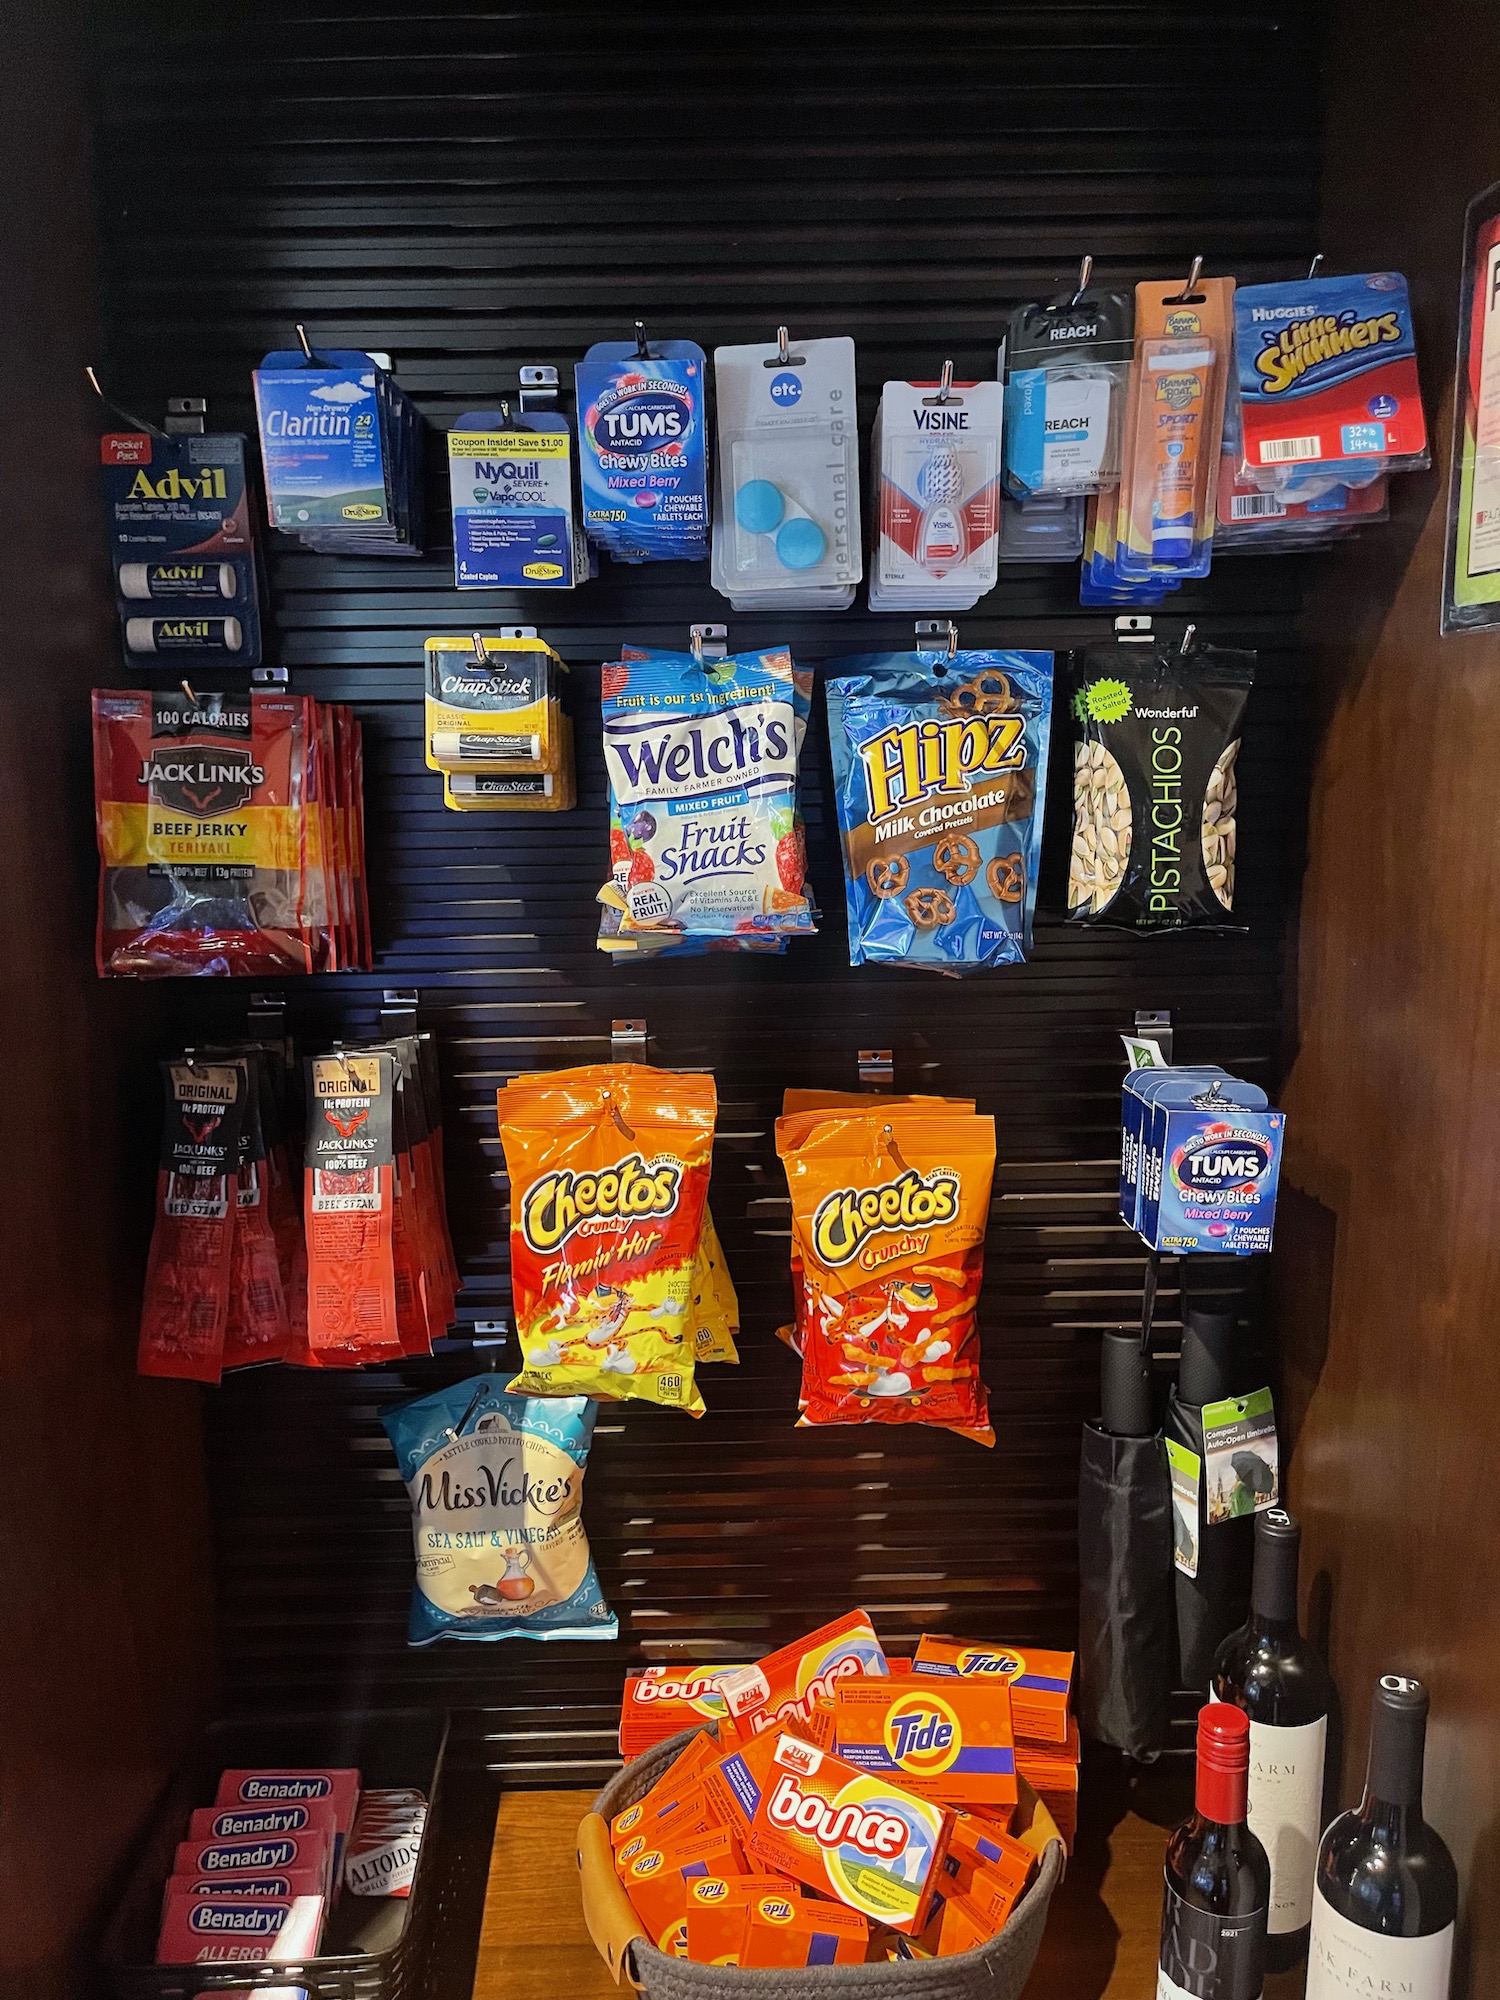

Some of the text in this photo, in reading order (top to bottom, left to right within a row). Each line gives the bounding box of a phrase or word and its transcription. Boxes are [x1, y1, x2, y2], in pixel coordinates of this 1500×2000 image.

[1252, 305, 1316, 322] HUGGIES
[1050, 324, 1097, 340] REACH
[617, 381, 688, 397] WORK IN SECONDS!
[772, 382, 802, 397] etc.
[1160, 378, 1198, 389] BANANA
[266, 410, 350, 437] Claritin
[356, 415, 371, 425] 24
[603, 412, 682, 437] TUMS
[913, 410, 969, 430] VISINE
[1045, 417, 1090, 430] REACH
[452, 438, 564, 447] Coupon Inside! Save $1.00
[610, 439, 642, 447] ANTACID
[1387, 432, 1397, 443] L
[110, 440, 144, 451] Pocket
[116, 451, 139, 461] Pack
[599, 453, 688, 472] Chewy Bites
[475, 461, 541, 485] NyQuil
[126, 467, 228, 499] Advil
[608, 475, 681, 490] Mixed Berry
[826, 389, 854, 583] personal care
[490, 491, 546, 503] VapoCOOL
[669, 495, 703, 503] POUCHES
[610, 510, 626, 521] 750
[664, 504, 702, 512] CHEWABLE
[652, 512, 703, 521] TABLETS EACH
[151, 565, 204, 579] Advil
[459, 561, 467, 573] 4
[543, 566, 561, 575] Store
[460, 573, 499, 582] Coated Caplets
[158, 621, 209, 637] Advil
[441, 676, 531, 698] ChapStick
[616, 692, 704, 707] Fruit is our 1st
[1091, 689, 1123, 704] Roasted
[1094, 697, 1127, 713] & Salted
[1134, 705, 1197, 719] Wonderful
[156, 710, 249, 728] 100 CALORIES
[466, 735, 523, 744] ChapStick
[611, 713, 788, 787] Welch's
[138, 761, 264, 785] JACK LINK'S
[863, 718, 1025, 819] Flipz
[482, 781, 536, 792] ChapStick
[645, 766, 760, 796] FAMILY FARMER OWNED
[675, 794, 743, 813] MIXED FRUIT
[875, 789, 1006, 845] Milk Chocolate
[1150, 726, 1183, 911] PISTACHIOS
[153, 823, 248, 837] BEEF JERKY
[681, 815, 752, 852] Fruit
[914, 816, 974, 839] Covered Pretzels
[169, 841, 231, 854] TERIYAKI
[659, 840, 767, 882] Snacks
[173, 866, 194, 877] 100%
[215, 867, 253, 879] 13g PROTEIN
[633, 892, 661, 908] REAL
[690, 888, 757, 897] Excellent Source
[690, 896, 696, 904] of
[632, 902, 669, 919] FRUIT!
[179, 1084, 233, 1100] ORIGINAL
[319, 1080, 376, 1093] ORIGINAL
[192, 1104, 226, 1115] PROTEIN
[335, 1097, 371, 1108] PROTEIN
[1204, 1130, 1270, 1142] WORK IN SECONDS!
[172, 1143, 195, 1155] JACK
[316, 1139, 375, 1151] JACK LINK'S
[196, 1165, 217, 1176] BEEF
[325, 1159, 368, 1170] 100% BEEF
[1188, 1156, 1259, 1177] TUMS
[318, 1199, 374, 1210] BEEF STEAK
[526, 1156, 674, 1248] Cheetos
[1179, 1190, 1261, 1205] Chewy Bites
[818, 1174, 955, 1259] Cheetos
[1184, 1208, 1253, 1221] Mixed Berry
[577, 1216, 631, 1238] Crunchy
[1239, 1227, 1270, 1235] POUCHES
[1182, 1237, 1198, 1247] 750
[1221, 1241, 1269, 1250] TABLETS EACH
[1232, 1234, 1269, 1242] CHEWABLE
[861, 1234, 928, 1270] Crunchy
[542, 1230, 662, 1291] Flamin' Hot
[659, 1375, 680, 1387] 460
[1206, 1426, 1238, 1440] Compact
[1207, 1425, 1276, 1449] Auto-Open Umbrella
[442, 1436, 547, 1461] KETTLE COOKED POTATO CHIPS
[418, 1457, 572, 1516] Miss Vickie's
[427, 1530, 502, 1549] SEA SALT &
[963, 1653, 1020, 1674] Tide
[838, 1689, 844, 1704] 1
[891, 1712, 954, 1761] Tide
[248, 1781, 323, 1798] Benadryl
[221, 1810, 299, 1835] Benadryl
[771, 1778, 904, 1853] bounce
[750, 1831, 758, 1843] 2
[207, 1844, 288, 1869] Benadryl
[634, 1852, 661, 1871] Tide
[351, 1842, 420, 1887] ALTOIDS
[360, 1877, 388, 1894] SMALLS
[697, 1881, 726, 1897] Tide
[763, 1902, 791, 1917] Tide
[198, 1907, 284, 1930] Benadryl
[1220, 1929, 1238, 1937] 2021
[1347, 1966, 1414, 1993] FARM
